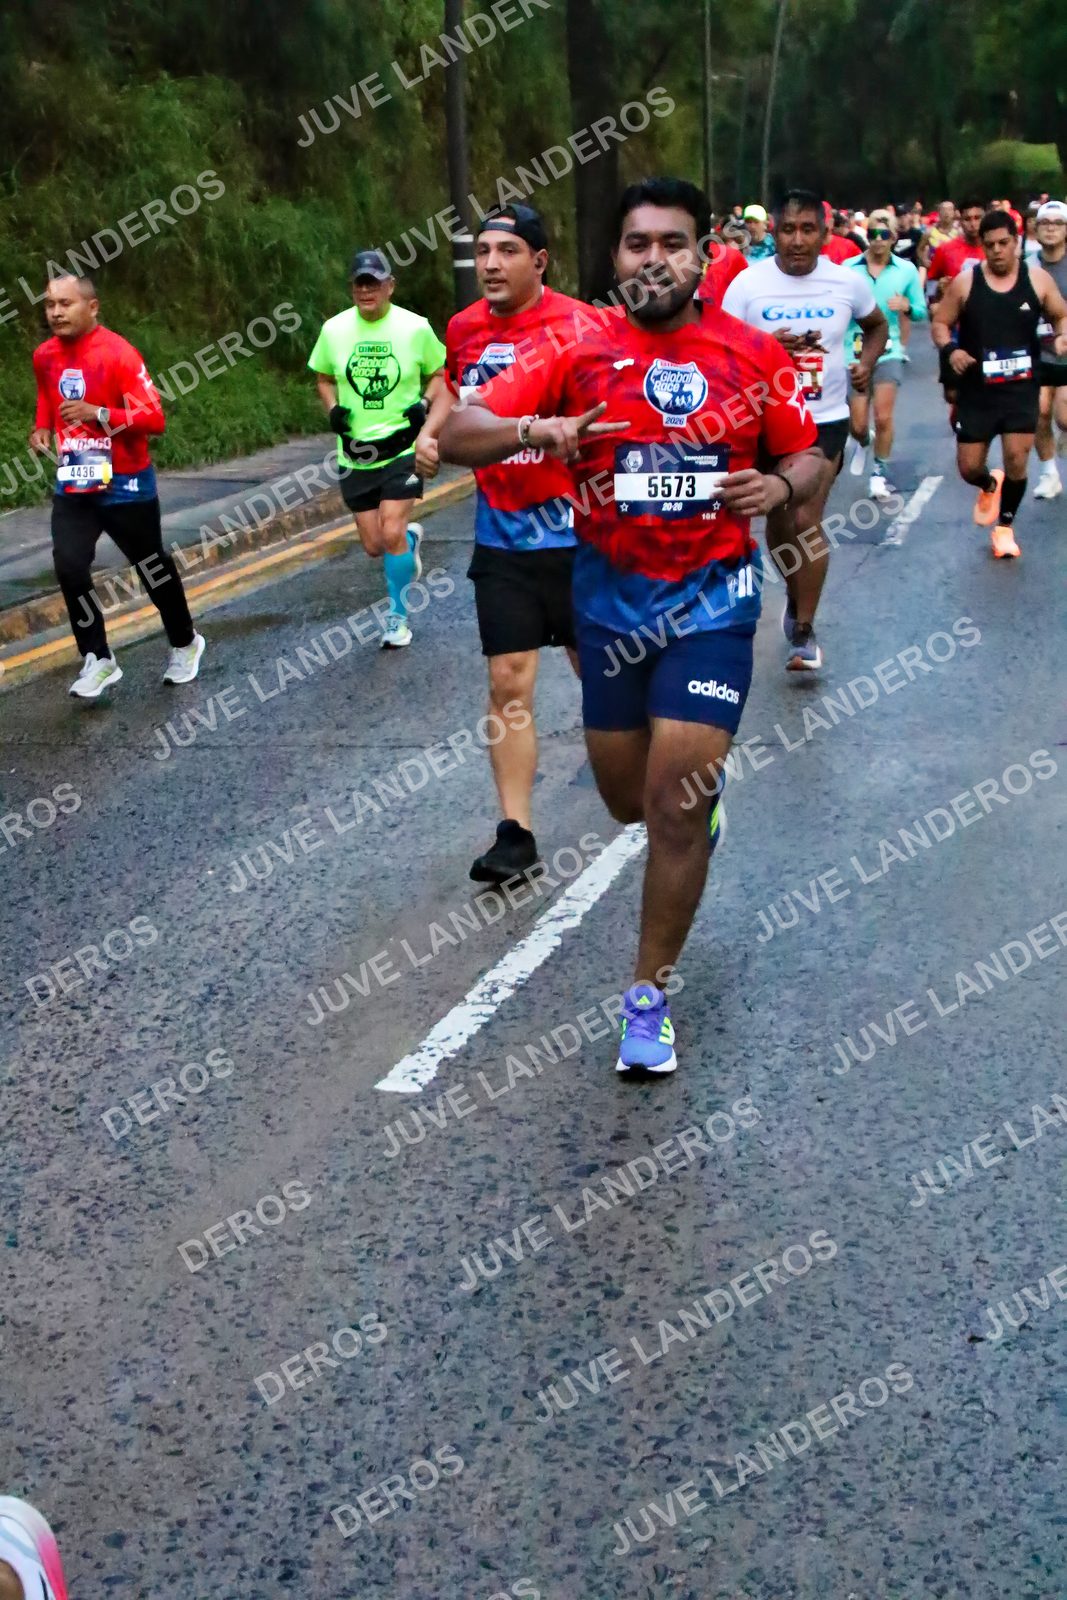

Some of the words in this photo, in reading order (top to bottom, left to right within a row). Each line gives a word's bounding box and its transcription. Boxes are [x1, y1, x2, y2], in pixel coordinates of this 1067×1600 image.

[762, 303, 834, 321] Gato
[660, 370, 693, 383] Global
[653, 380, 680, 392] Race
[665, 416, 685, 425] 2026
[70, 466, 95, 478] 4436
[648, 475, 696, 498] 5573
[687, 680, 740, 704] adidas
